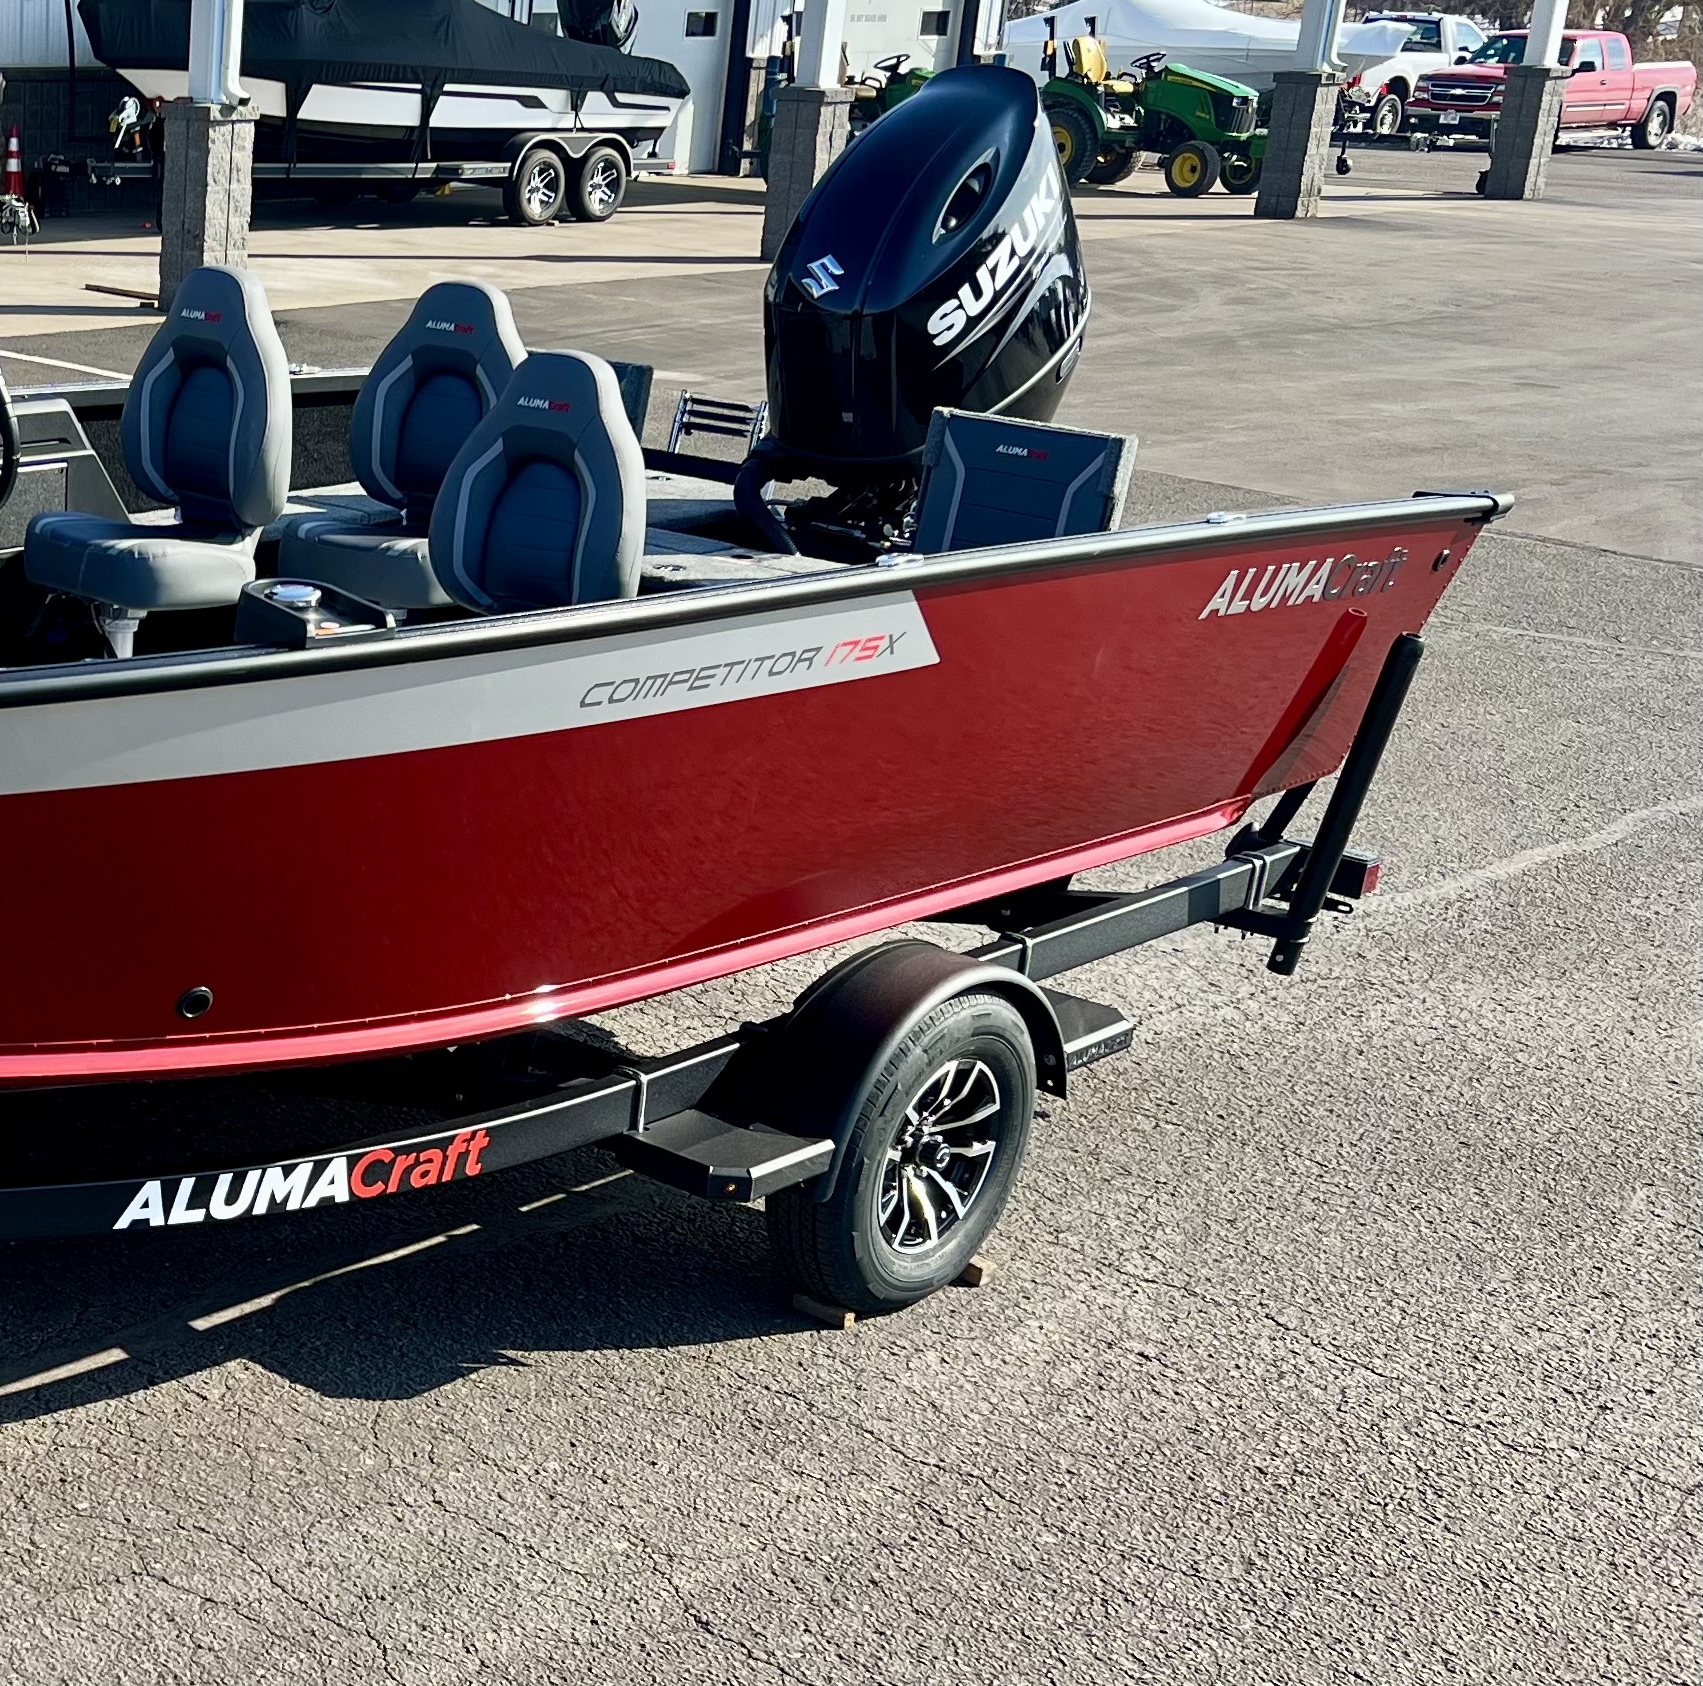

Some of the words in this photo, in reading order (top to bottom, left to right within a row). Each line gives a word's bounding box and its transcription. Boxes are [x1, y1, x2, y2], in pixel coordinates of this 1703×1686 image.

[927, 162, 1061, 346] SUZUKI
[180, 308, 222, 322] ALUMA
[425, 319, 474, 335] ALUMA
[517, 396, 571, 412] ALUMA
[995, 444, 1049, 460] ALUMA
[1198, 547, 1408, 620] ALUMACraft
[580, 646, 824, 709] COMPETITOR
[824, 631, 907, 668] 175X
[113, 1128, 491, 1230] ALUMACraft
